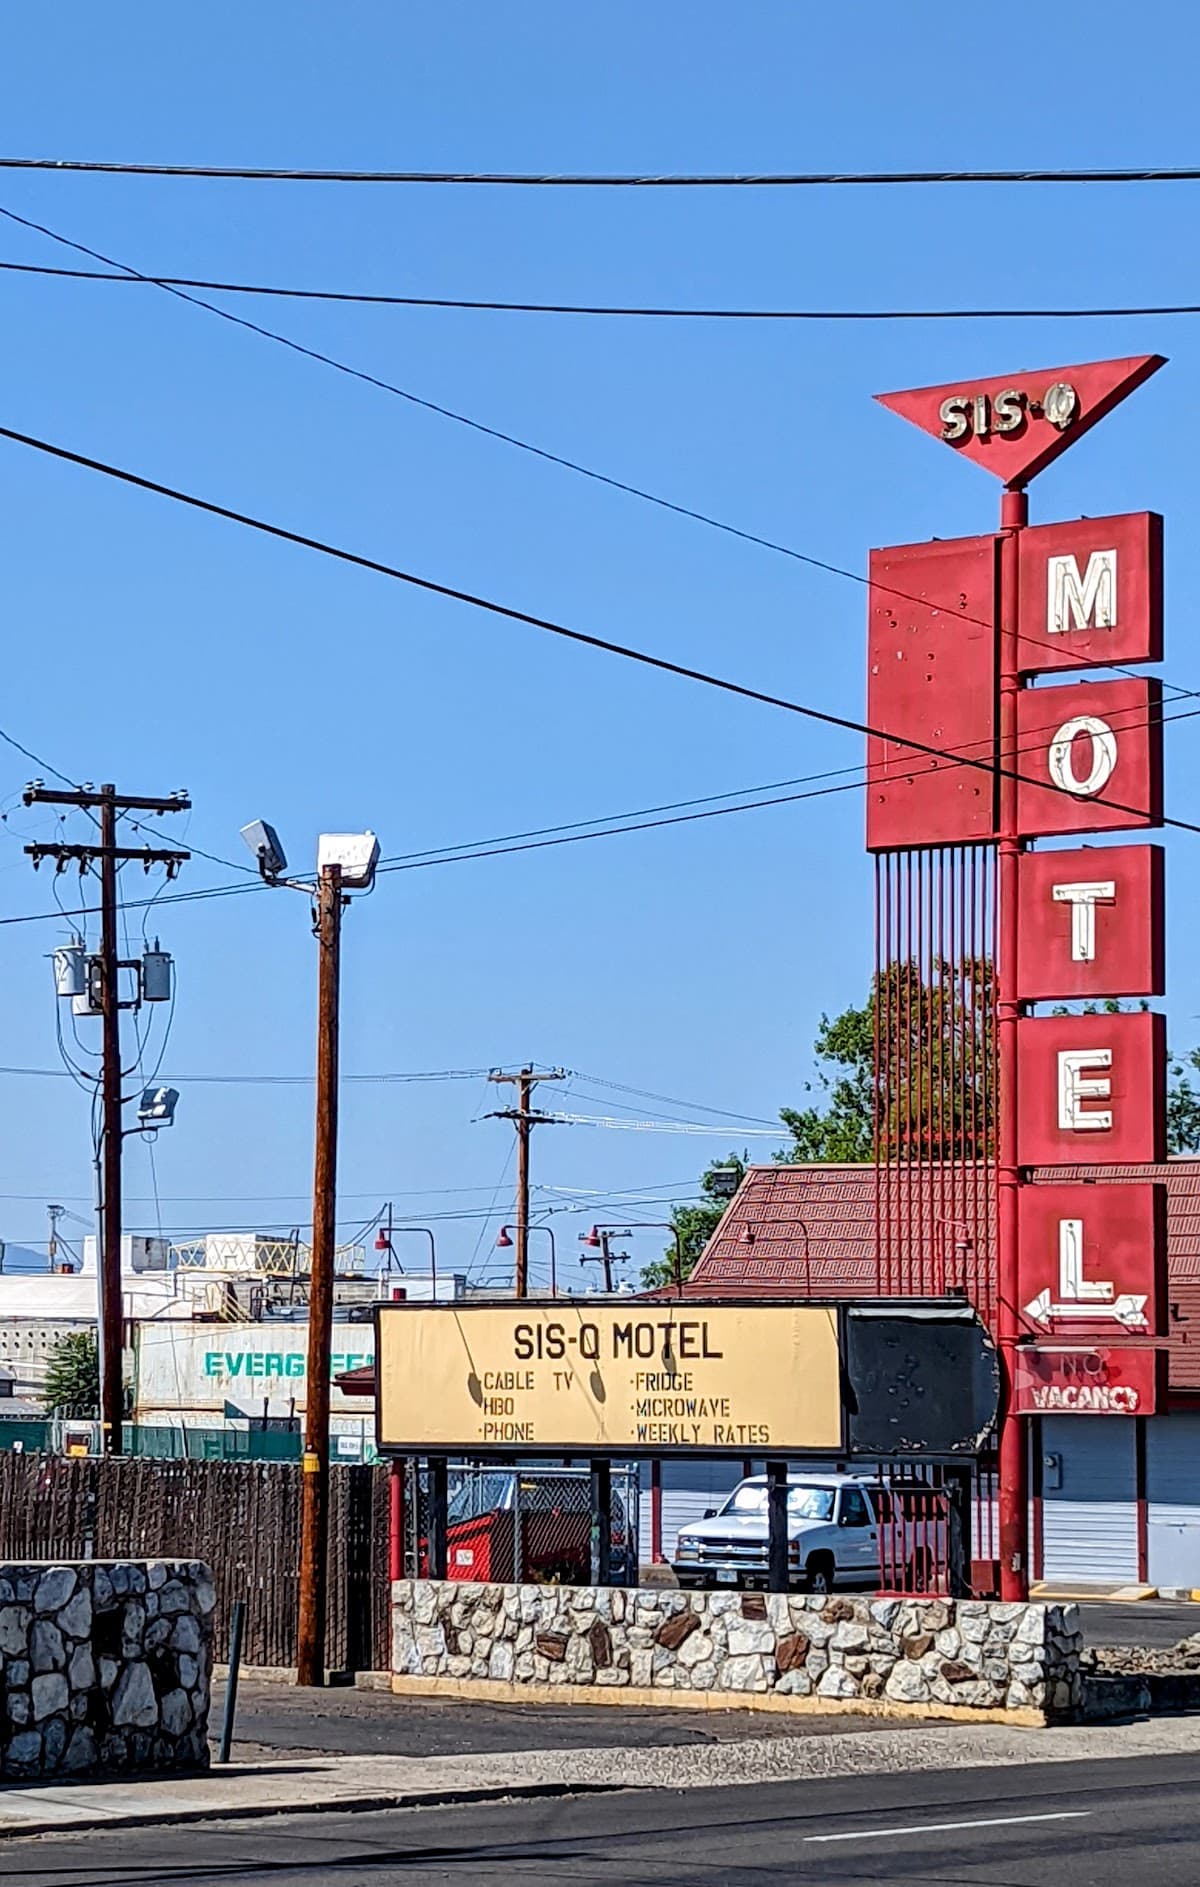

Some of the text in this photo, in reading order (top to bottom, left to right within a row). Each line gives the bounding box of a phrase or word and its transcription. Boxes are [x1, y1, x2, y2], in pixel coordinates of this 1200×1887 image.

[939, 382, 1076, 439] SIS-Q
[1047, 549, 1118, 1299] MOTEL
[514, 1321, 723, 1360] SIS-Q MOTEL
[204, 1352, 376, 1377] EVERGEE
[1060, 1352, 1103, 1376] NO
[484, 1371, 574, 1391] CABLE TV
[636, 1372, 693, 1391] FRIDGE
[484, 1397, 514, 1415] HBO
[636, 1398, 730, 1418] MICROWAVE
[484, 1421, 534, 1440] PHONE
[636, 1423, 770, 1444] WEEKLY RATES
